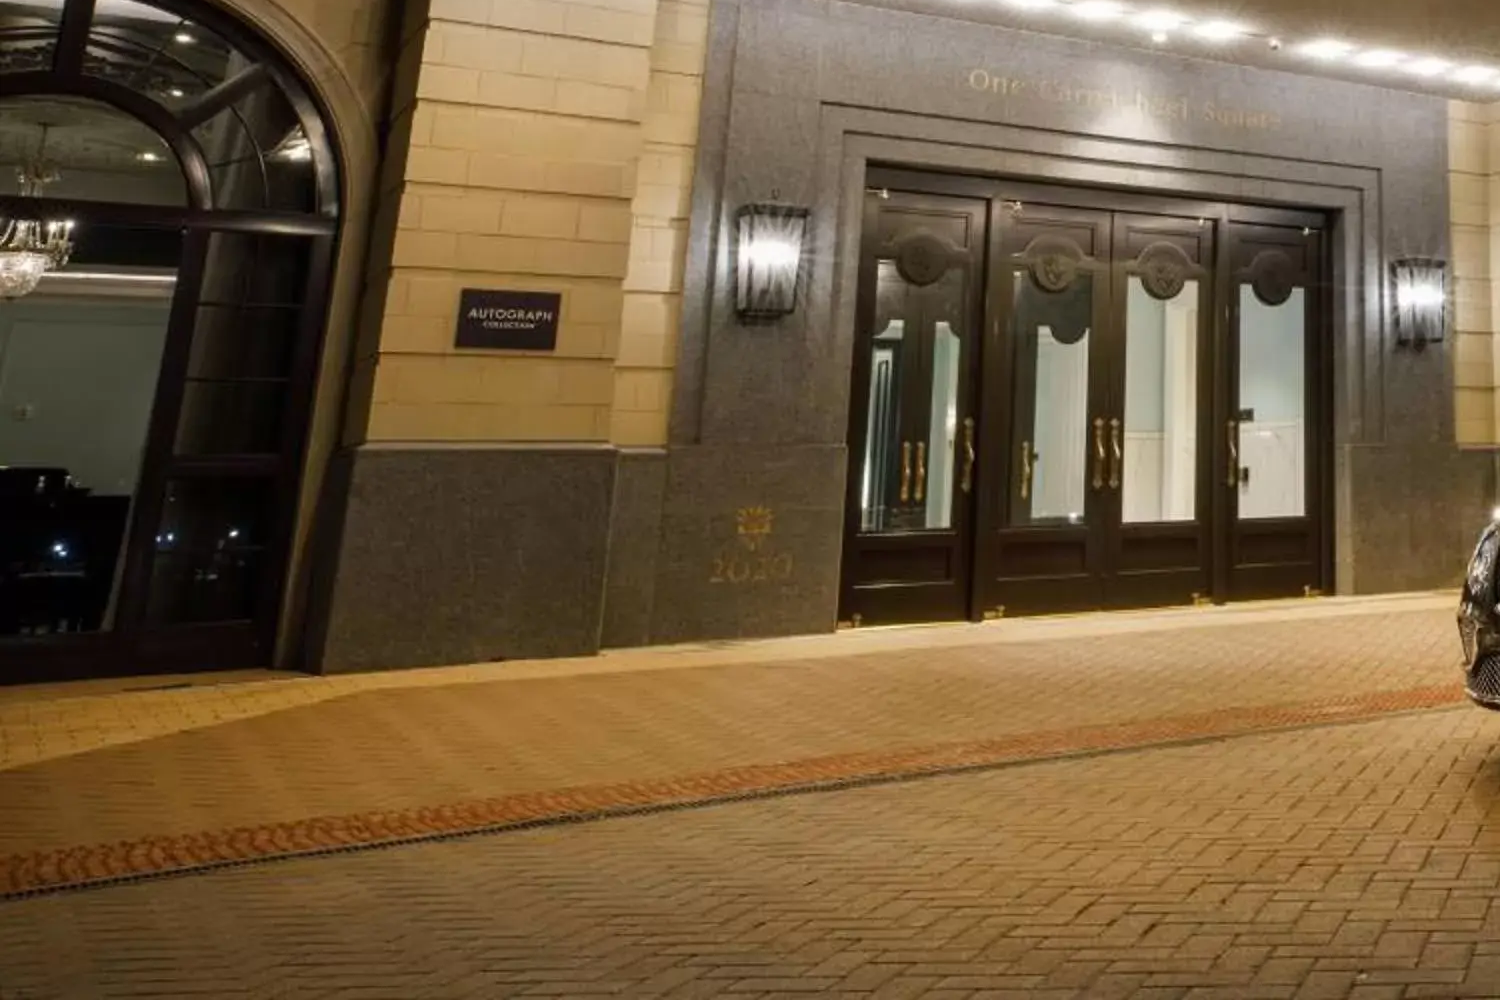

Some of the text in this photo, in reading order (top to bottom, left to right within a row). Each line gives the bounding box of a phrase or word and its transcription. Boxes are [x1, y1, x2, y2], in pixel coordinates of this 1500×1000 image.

[968, 68, 1024, 96] One
[1039, 78, 1188, 121] Carmihael
[468, 308, 553, 322] AUTOGRAPH
